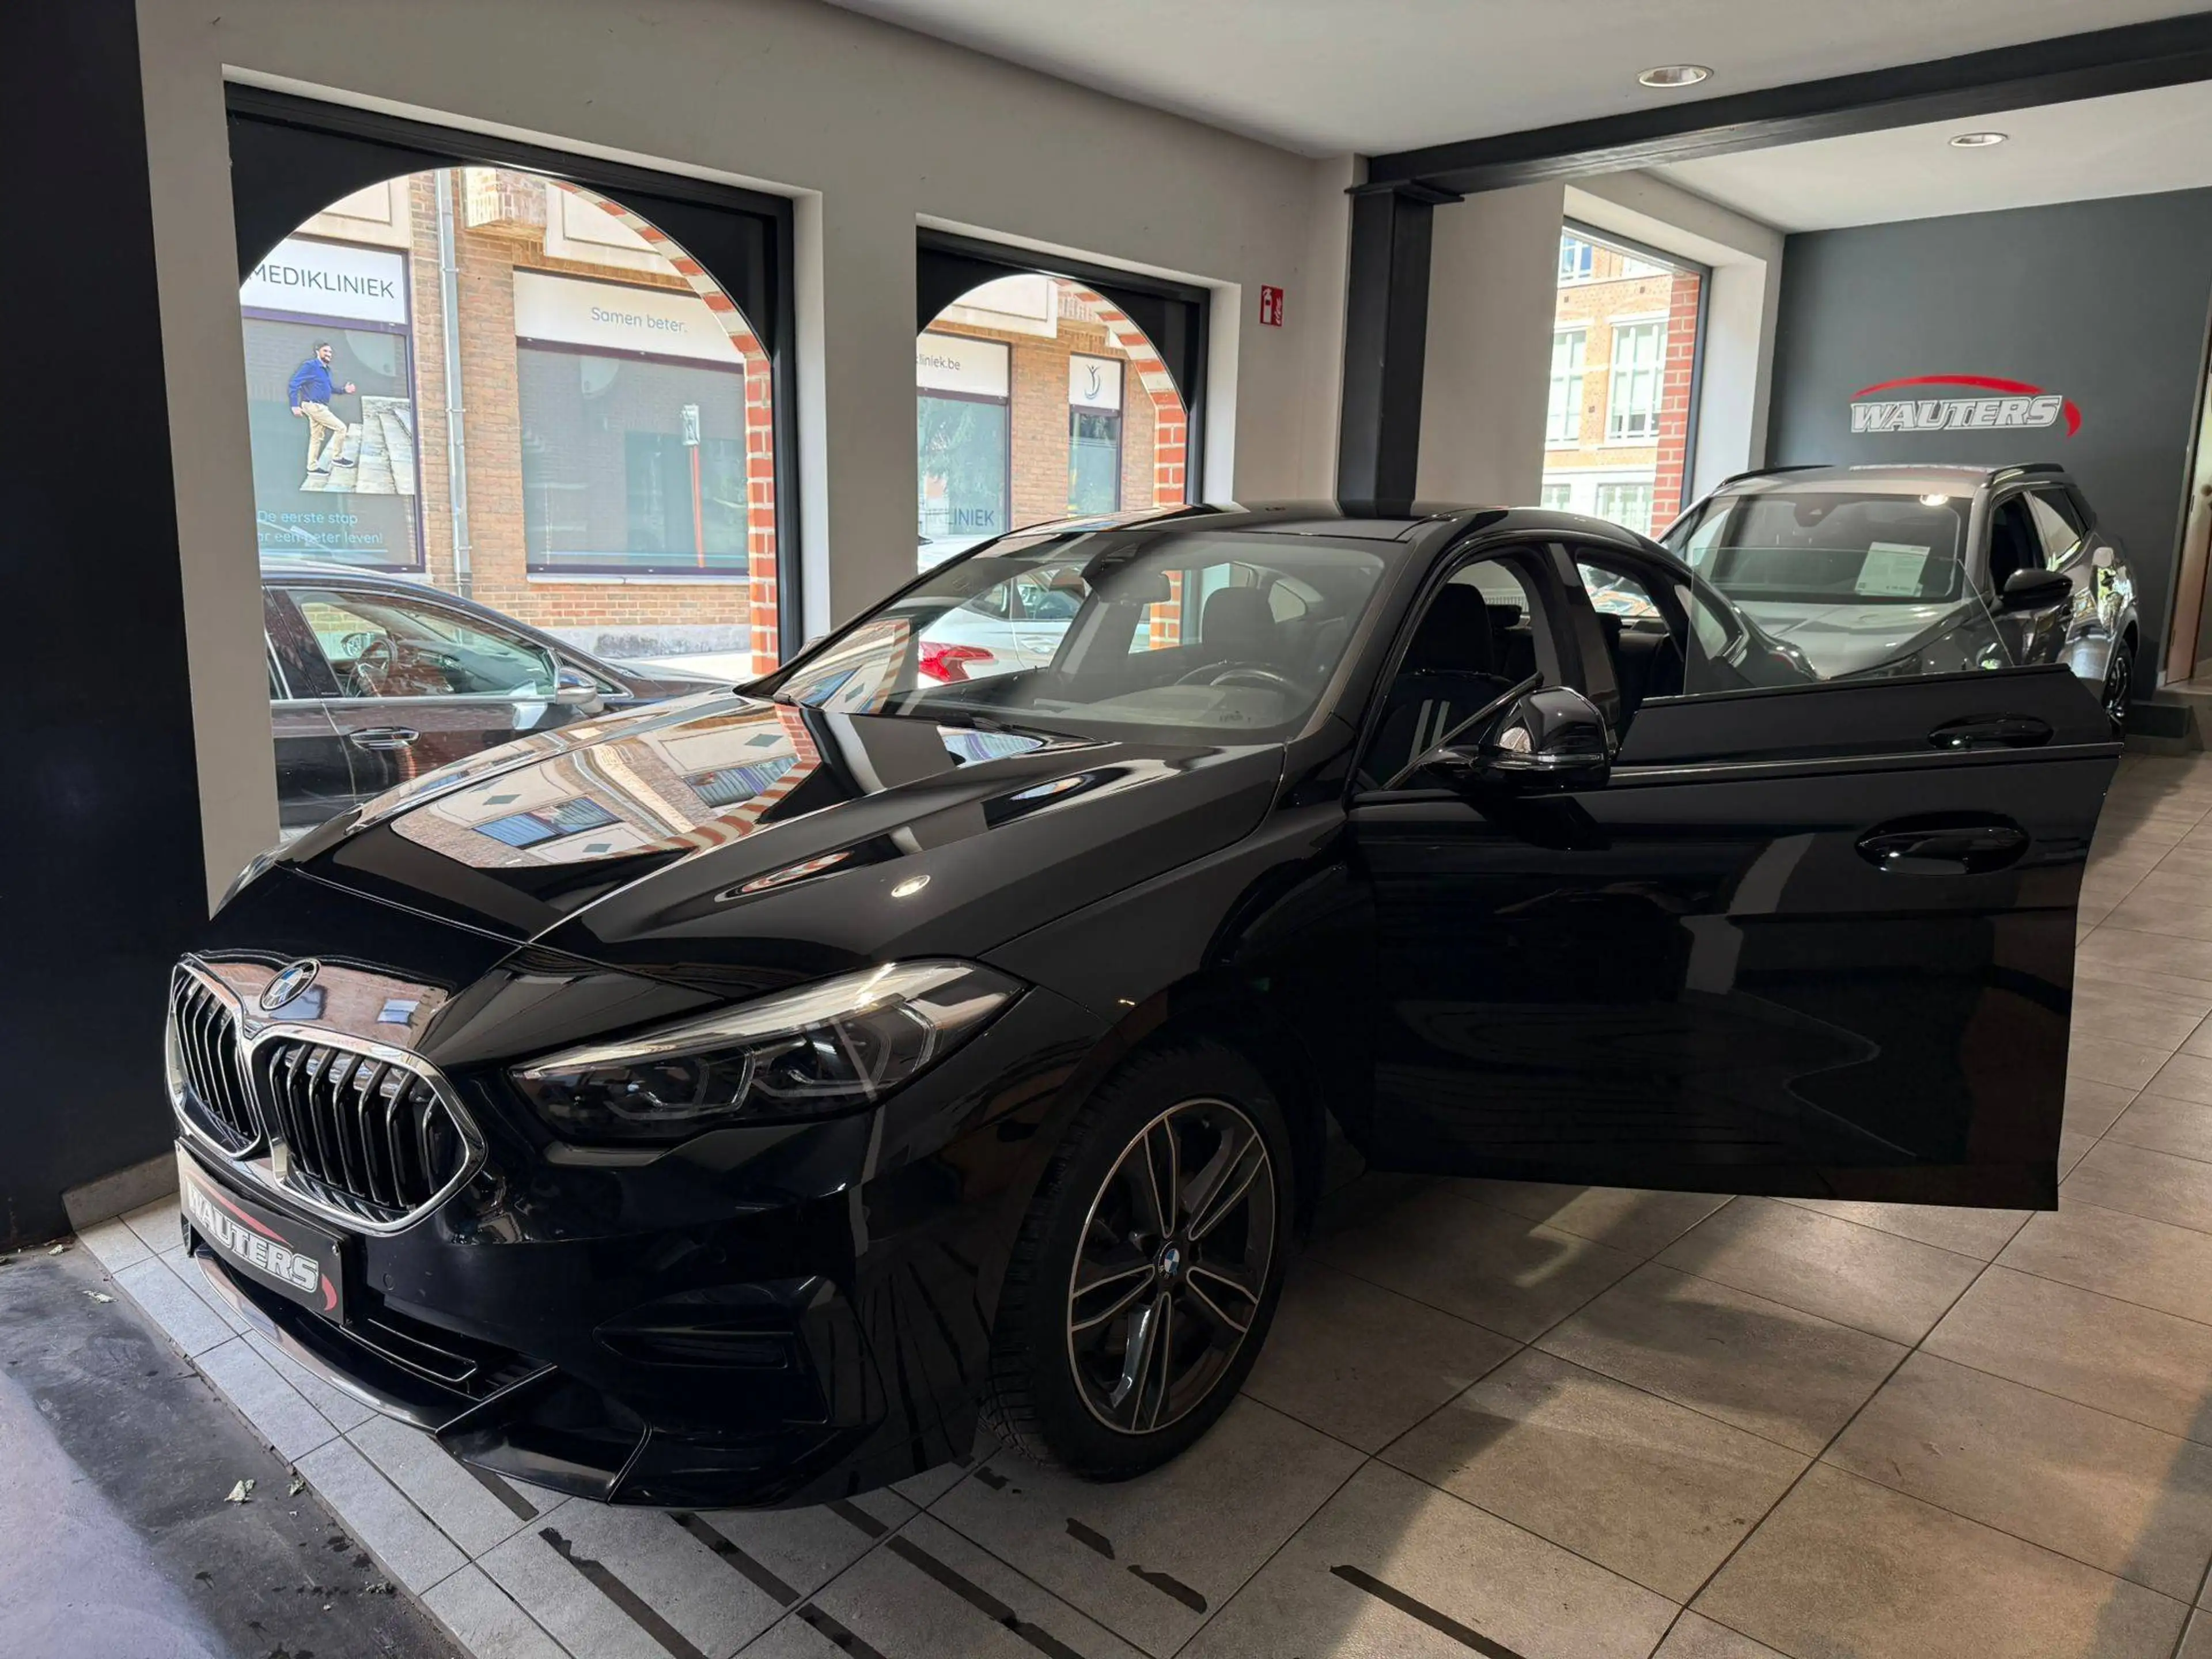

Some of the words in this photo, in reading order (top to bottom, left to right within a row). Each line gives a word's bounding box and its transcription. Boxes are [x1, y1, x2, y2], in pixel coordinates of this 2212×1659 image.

[249, 264, 394, 298] MEDIKLINIEK
[592, 307, 642, 327] Samen
[647, 314, 688, 332] beter.
[917, 354, 960, 370] liniek.be
[1851, 396, 2063, 433] WAUTERS
[258, 510, 276, 522] De
[281, 513, 324, 524] eerste
[328, 514, 358, 526] stap
[275, 533, 300, 543] een
[305, 532, 341, 544] eter
[345, 531, 383, 544] leven!
[185, 1176, 319, 1293] WAUTERS
